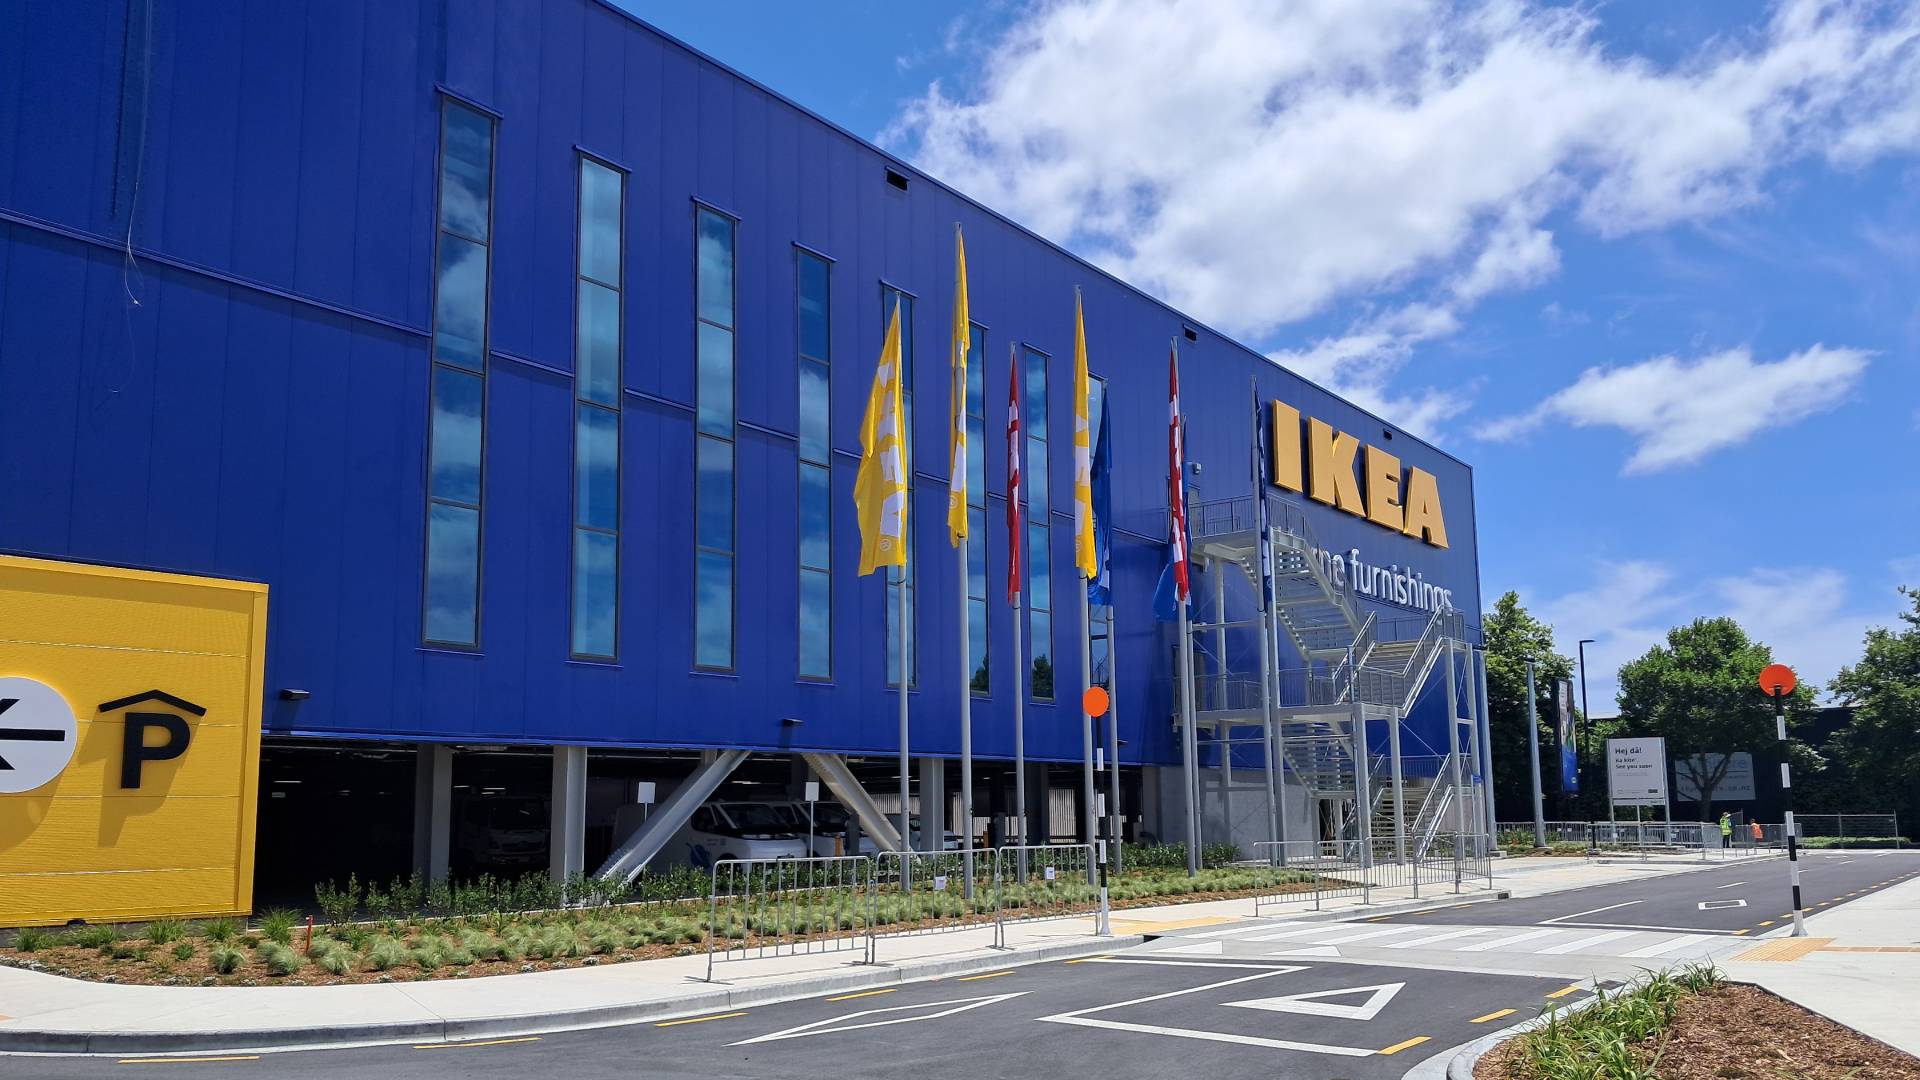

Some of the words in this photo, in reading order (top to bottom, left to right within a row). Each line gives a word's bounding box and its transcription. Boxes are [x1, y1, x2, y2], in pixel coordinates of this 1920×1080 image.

[1272, 399, 1449, 550] IKEA
[1350, 548, 1453, 621] furnishings
[121, 712, 190, 789] P
[1615, 747, 1628, 755] Hej
[1629, 746, 1642, 754] då!
